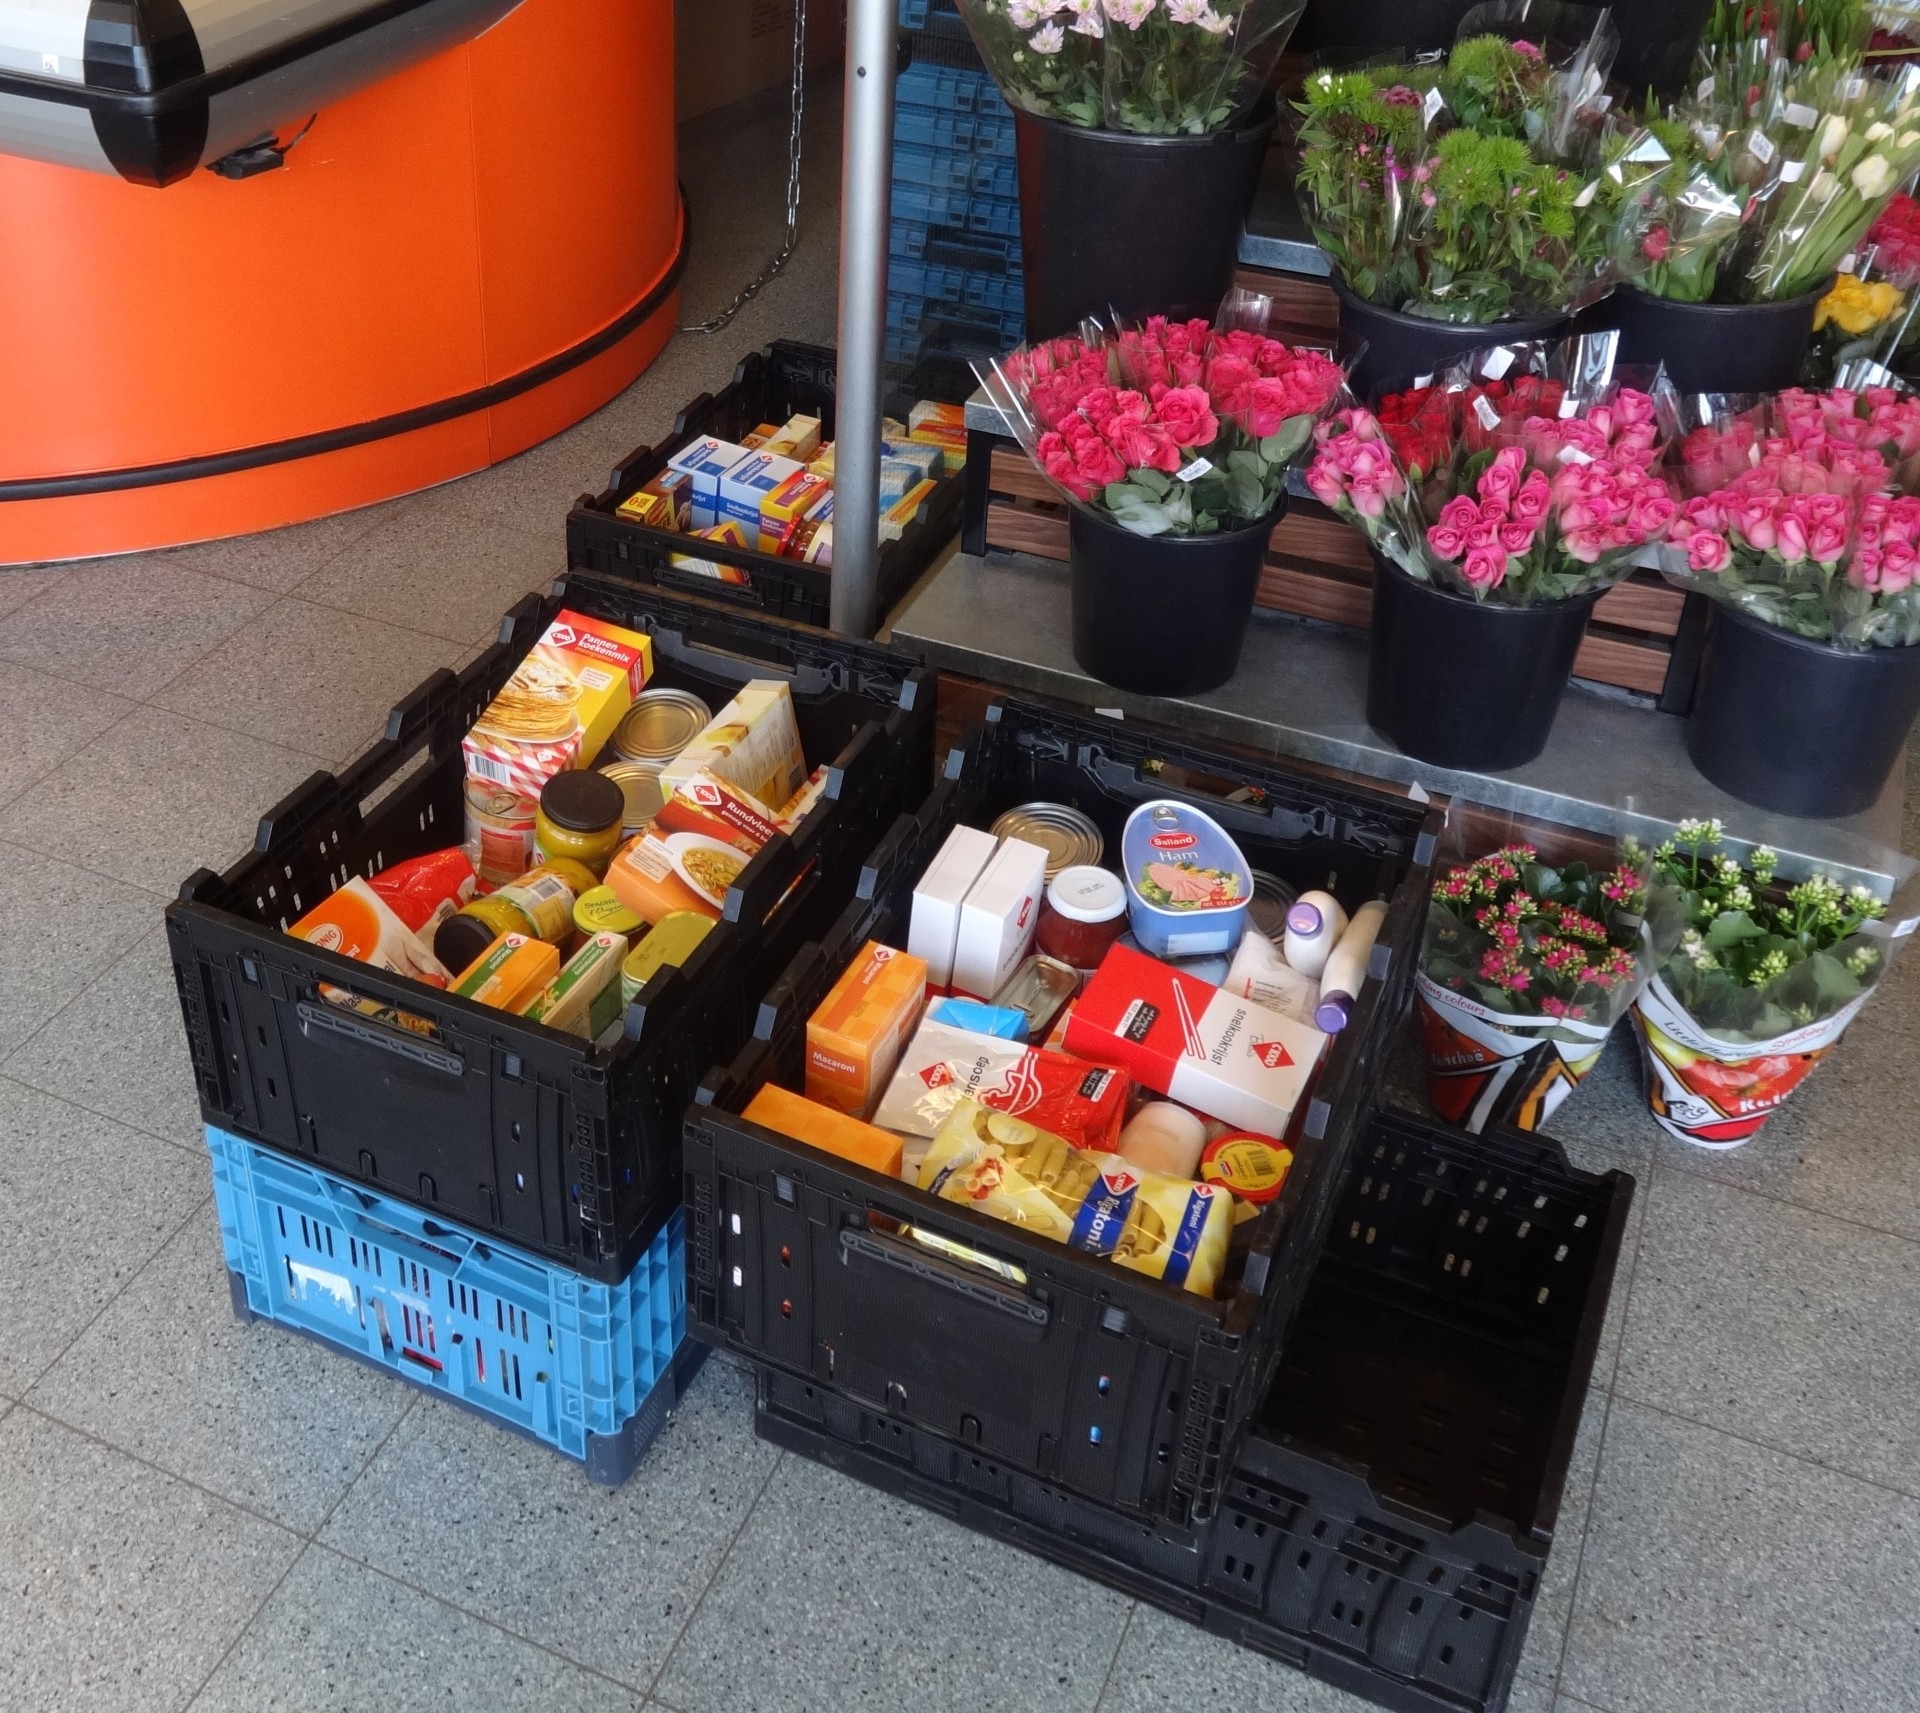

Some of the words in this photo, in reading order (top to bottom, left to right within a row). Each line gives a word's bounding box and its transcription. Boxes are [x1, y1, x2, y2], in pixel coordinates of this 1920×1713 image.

[578, 640, 630, 663] koekenmix
[581, 633, 619, 651] Pannen
[695, 786, 716, 802] C1000
[1153, 836, 1193, 846] Salland
[1159, 851, 1199, 862] Ham
[1444, 994, 1486, 1017] colours
[1210, 1008, 1247, 1066] snelkookrijst
[1664, 1021, 1698, 1046] Little
[813, 1051, 856, 1073] Macaroni
[1264, 1043, 1283, 1067] C1000
[1114, 1174, 1126, 1192] C1000
[1086, 1196, 1120, 1249] Rigatoni
[1188, 1199, 1206, 1229] Rigatoni
